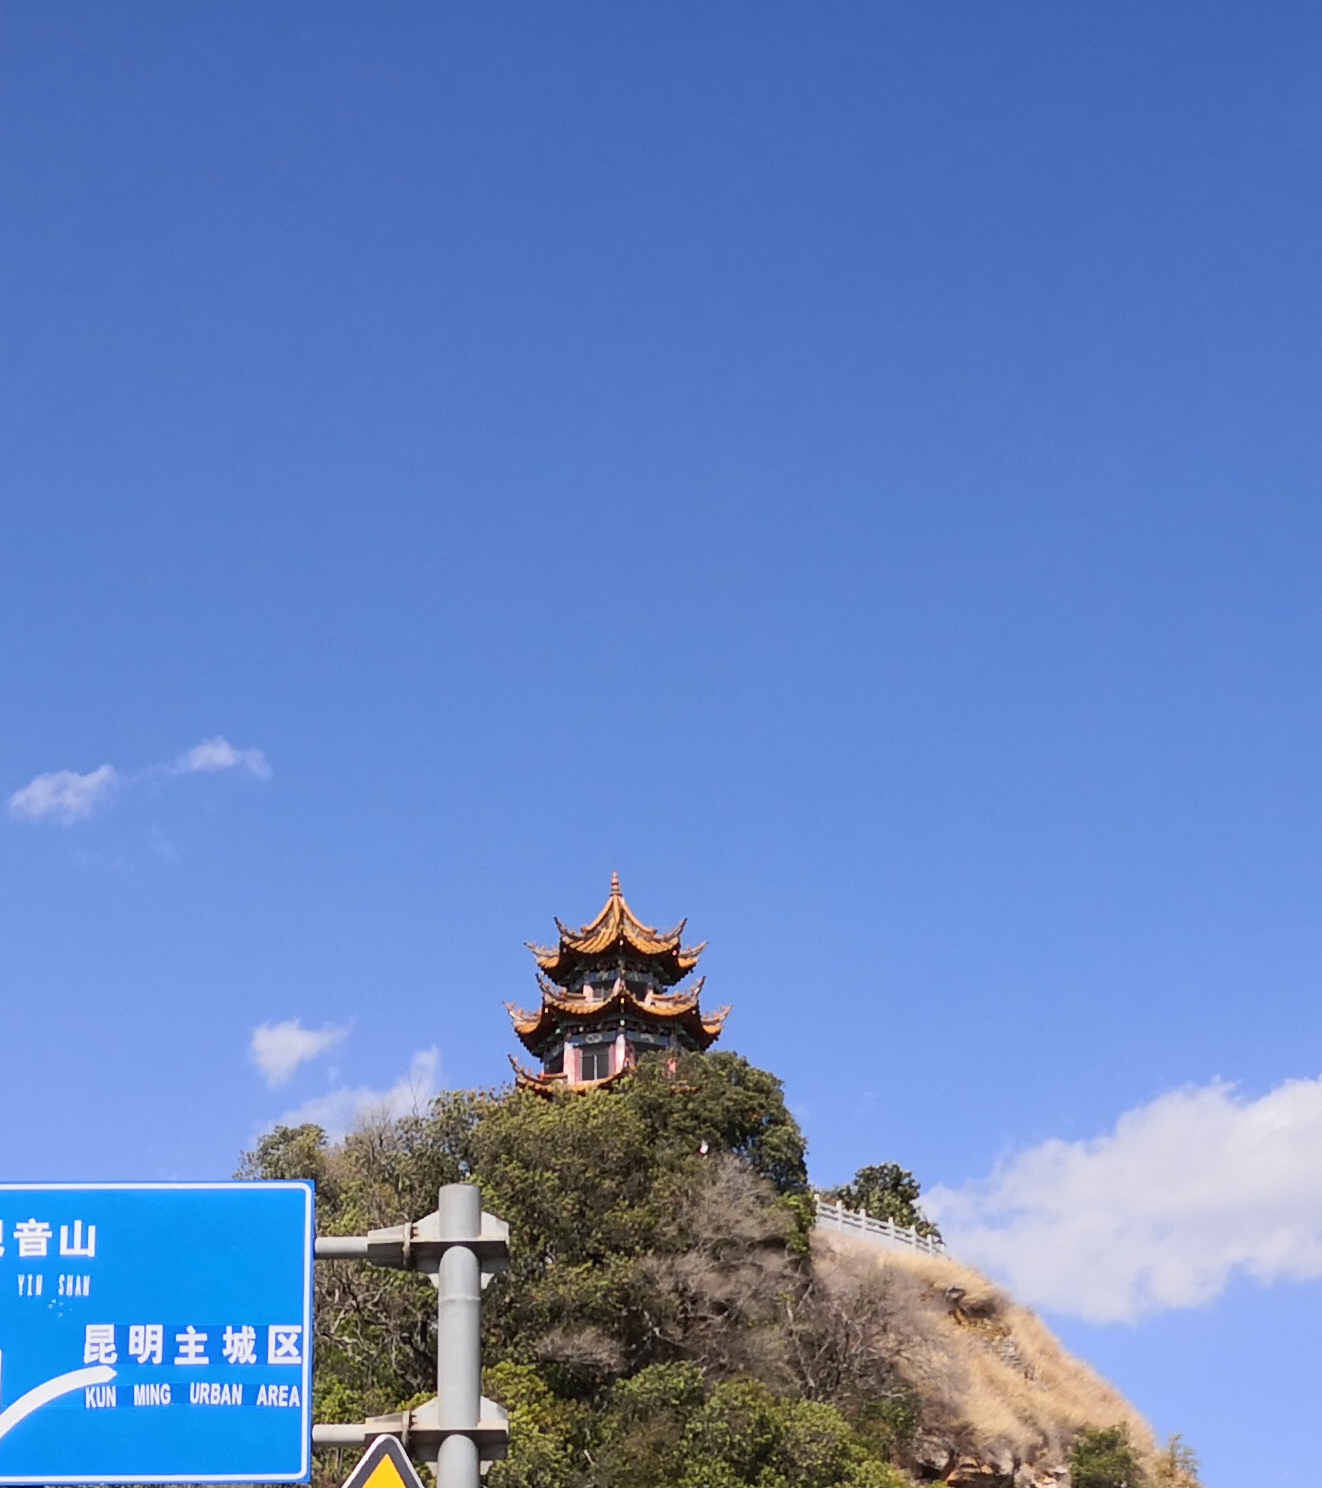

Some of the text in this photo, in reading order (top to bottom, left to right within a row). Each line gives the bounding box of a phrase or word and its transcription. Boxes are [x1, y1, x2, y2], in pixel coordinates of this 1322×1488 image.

[18, 1274, 43, 1296] YIN
[58, 1274, 90, 1297] SHAN
[83, 1323, 302, 1365] 昆明主城区
[85, 1382, 300, 1408] KUN MING URBAN AREA
